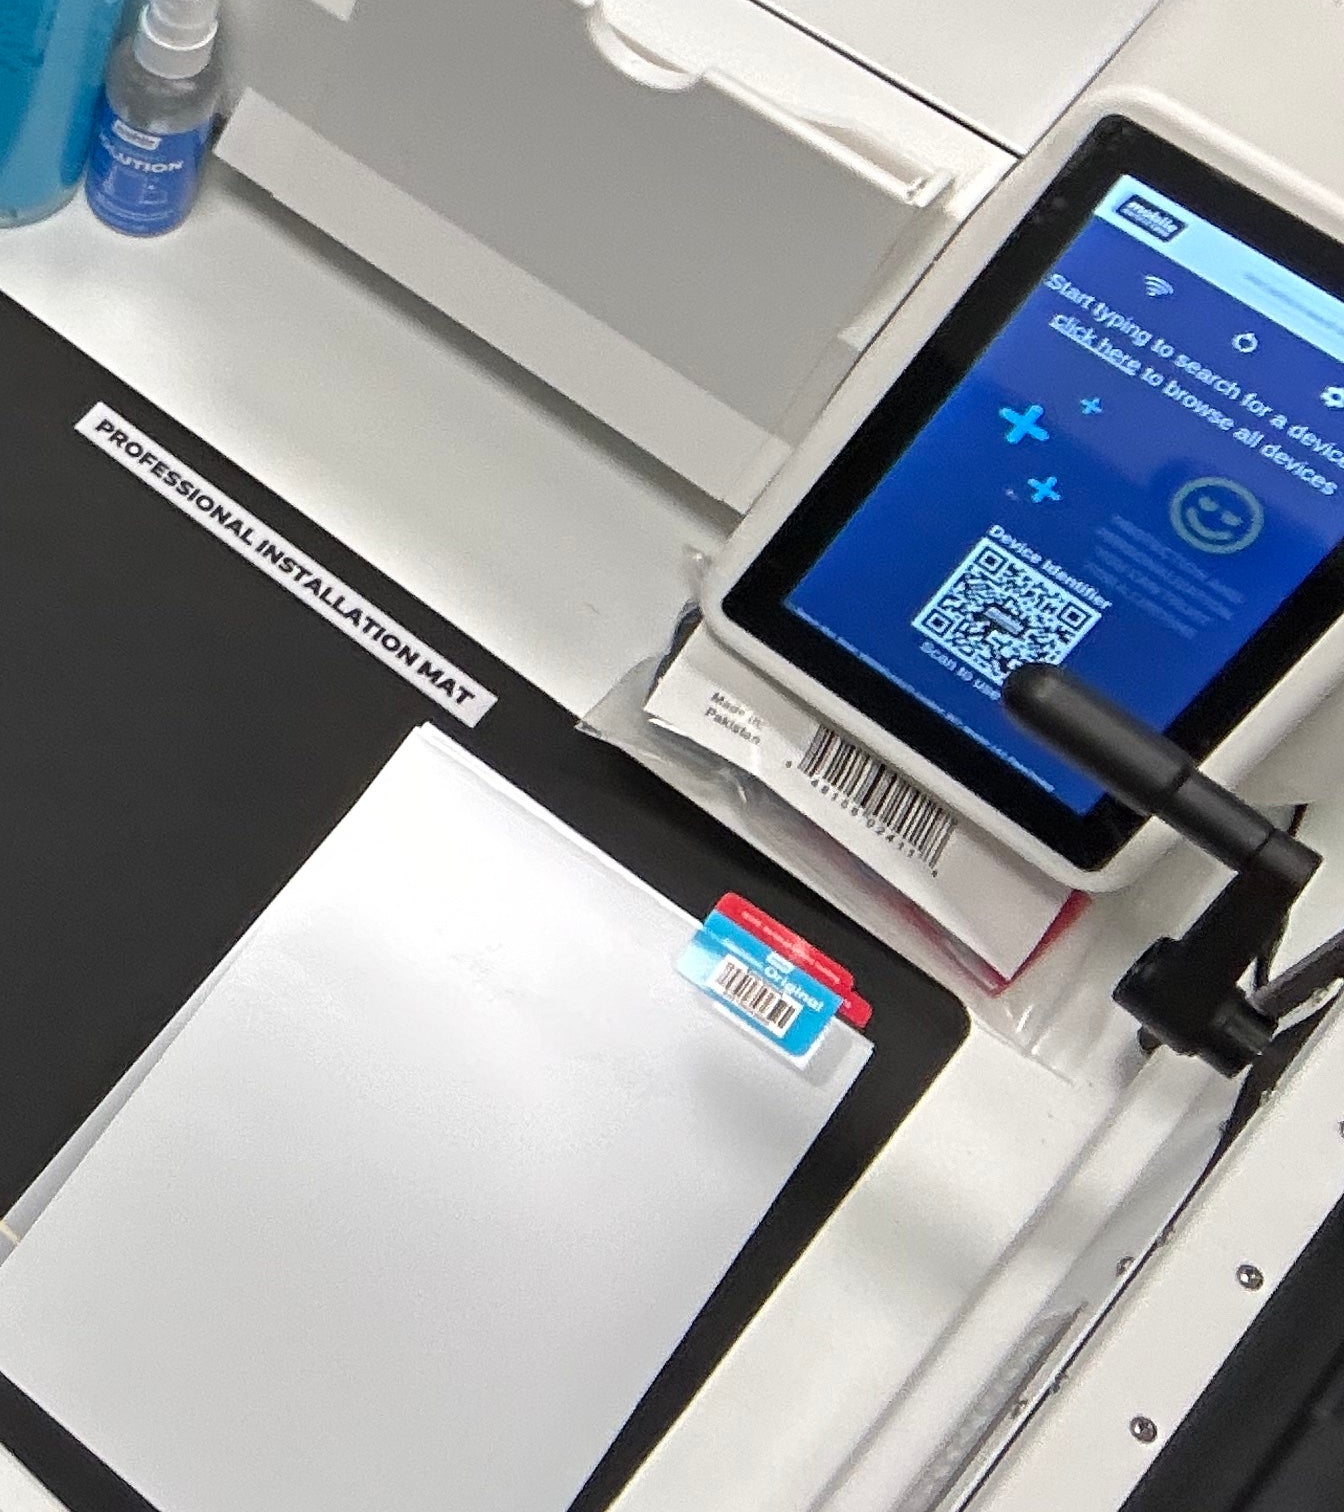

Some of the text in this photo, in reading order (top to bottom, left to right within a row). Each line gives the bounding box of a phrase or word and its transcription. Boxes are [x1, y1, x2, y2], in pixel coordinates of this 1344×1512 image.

[1044, 273, 1096, 309] Start
[1092, 302, 1153, 347] typing
[1151, 339, 1175, 358] to
[1174, 354, 1241, 400] search
[1239, 392, 1273, 417] for
[1269, 414, 1288, 429] a
[1049, 314, 1338, 495] click here to browse all devices
[95, 418, 476, 707] PROFESSIONAL INSTALLATION MAT
[989, 524, 1112, 609] Device Identifier
[920, 641, 957, 672] Scan
[956, 667, 973, 682] to
[705, 706, 761, 746] Pakistan
[765, 966, 824, 1012] Original
